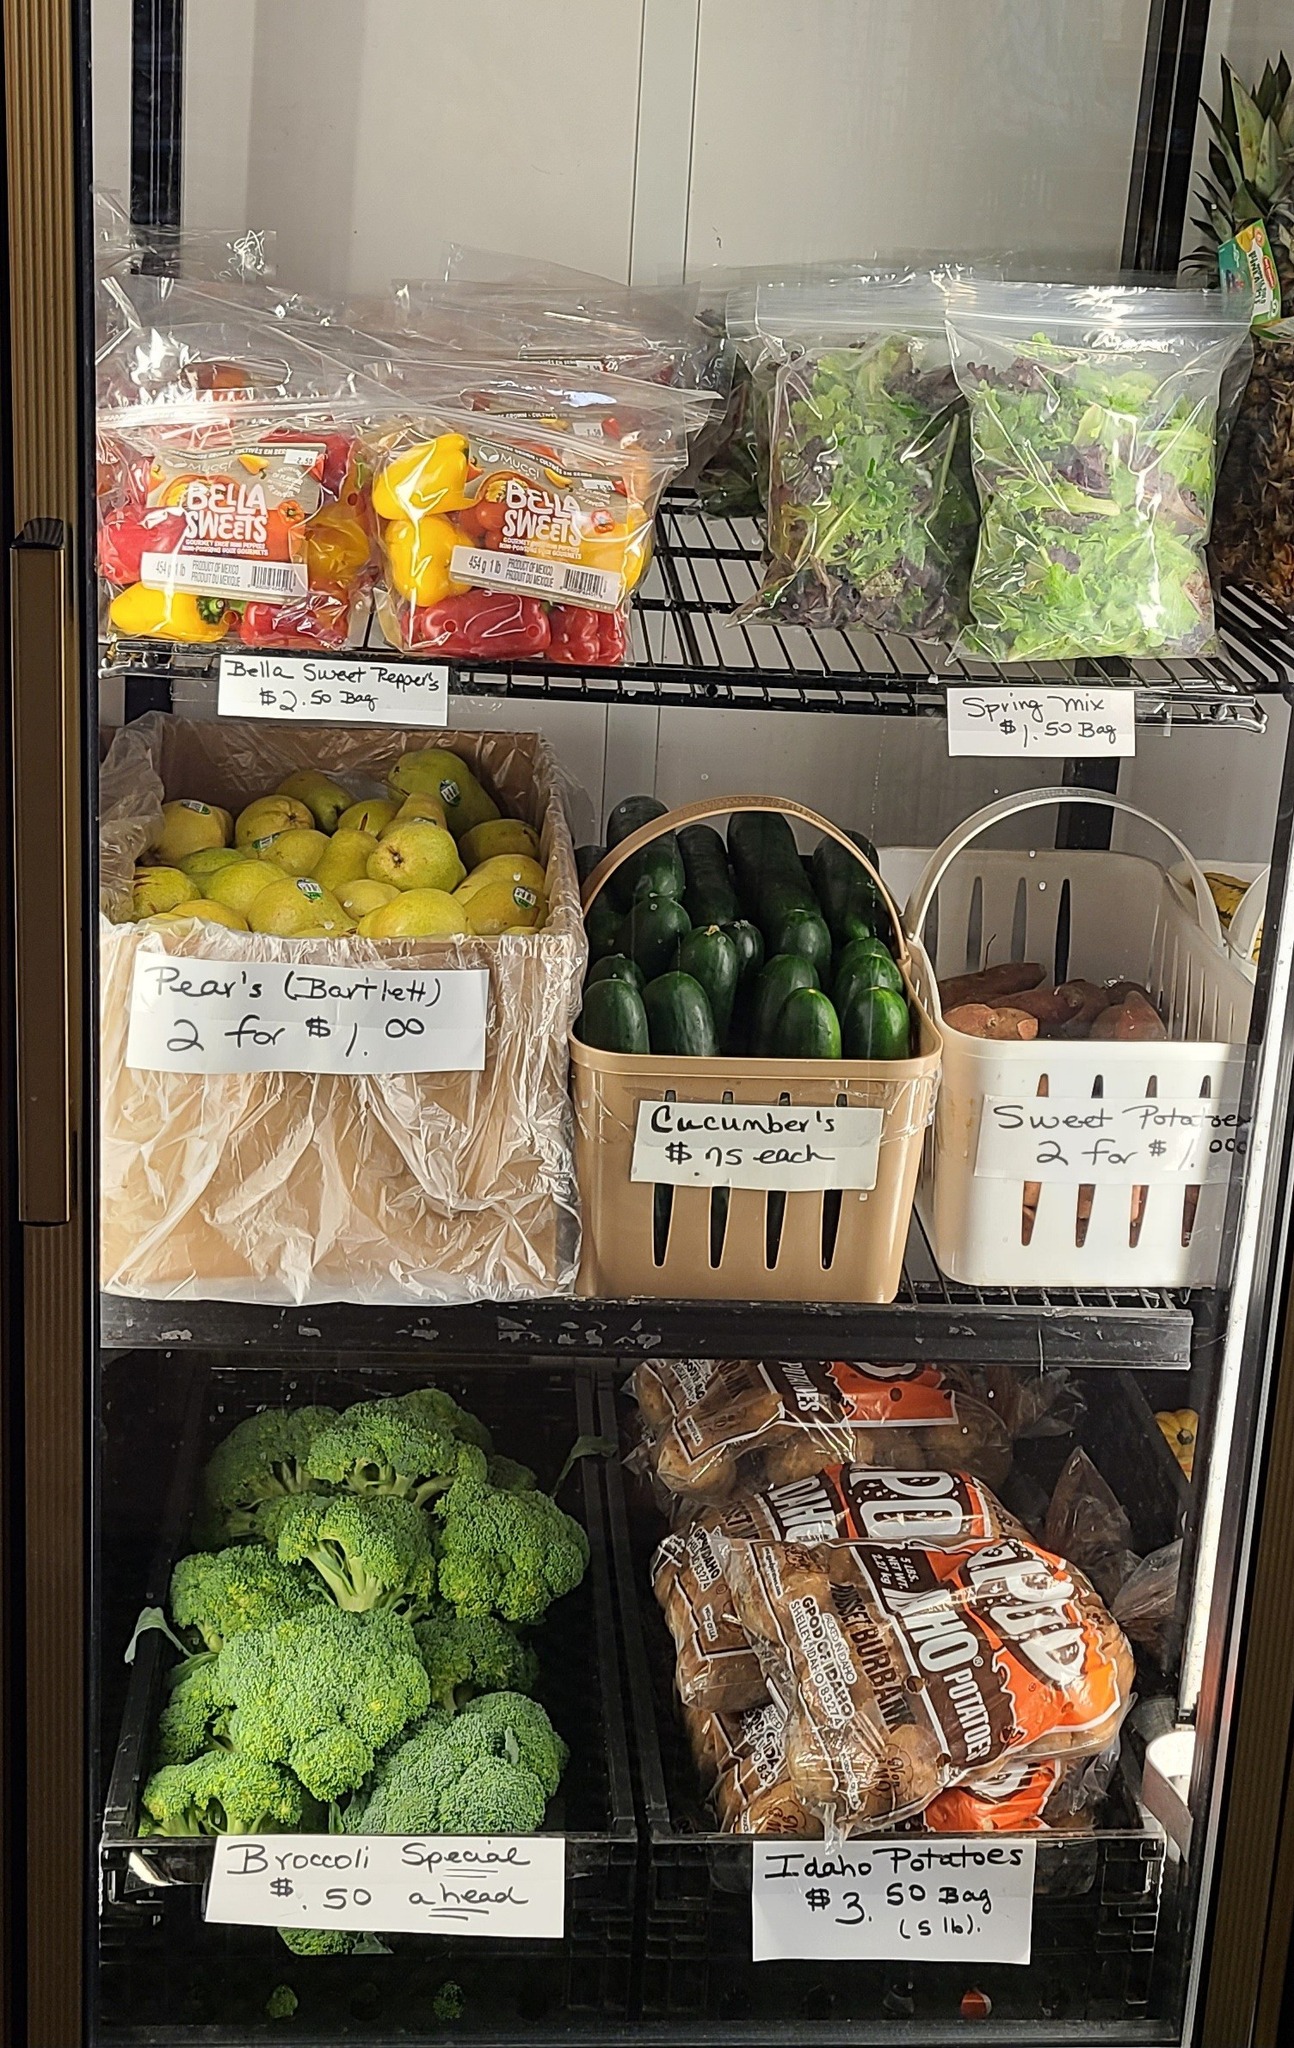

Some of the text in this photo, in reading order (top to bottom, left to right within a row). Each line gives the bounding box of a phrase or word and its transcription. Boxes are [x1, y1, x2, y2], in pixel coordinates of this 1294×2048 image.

[186, 483, 268, 520] BELLA
[505, 480, 581, 519] BELLA
[186, 510, 267, 543] SWEETS
[502, 510, 582, 547] SWEETS
[191, 572, 212, 584] PRODUIT
[212, 575, 219, 584] DU
[219, 575, 241, 588] MEXIQUE
[192, 560, 240, 574] PRODUCT OF MEXICO
[468, 555, 482, 570] 454
[481, 560, 487, 574] g
[494, 559, 502, 574] lb
[505, 568, 554, 588] PRODUIT DU MEXIQUE
[507, 557, 554, 577] PRODUCT OF MEXICO
[224, 660, 294, 679] Bella
[303, 663, 366, 683] Sweet
[340, 690, 378, 711] Bag
[962, 693, 1044, 723] Spring
[1078, 721, 1117, 744] Bag
[144, 966, 441, 1007] Pear's (Bartlett)
[166, 1018, 205, 1052] 2
[225, 1014, 286, 1049] for
[650, 1104, 835, 1135] Cucumber's
[993, 1104, 1113, 1130] Sweet
[752, 1144, 836, 1165] each
[1036, 1140, 1069, 1166] 2
[1081, 1138, 1138, 1166] for
[779, 1361, 821, 1413] POTATOES
[872, 1553, 893, 1586] 2.27 kg
[886, 1555, 910, 1590] NET WT.
[899, 1556, 920, 1583] 5 LBS.
[801, 1596, 824, 1640] GPOD
[823, 1662, 854, 1718] IDAHO
[836, 1651, 857, 1683] IDAHO
[806, 1648, 824, 1687] IDAHO
[820, 1688, 843, 1726] 83274
[850, 1622, 917, 1734] BURBANK
[943, 1668, 992, 1762] POTATOES
[226, 1840, 532, 1875] Broccoli Special
[764, 1844, 1025, 1880] Idaho Potatoes
[938, 1885, 993, 1915] Bag
